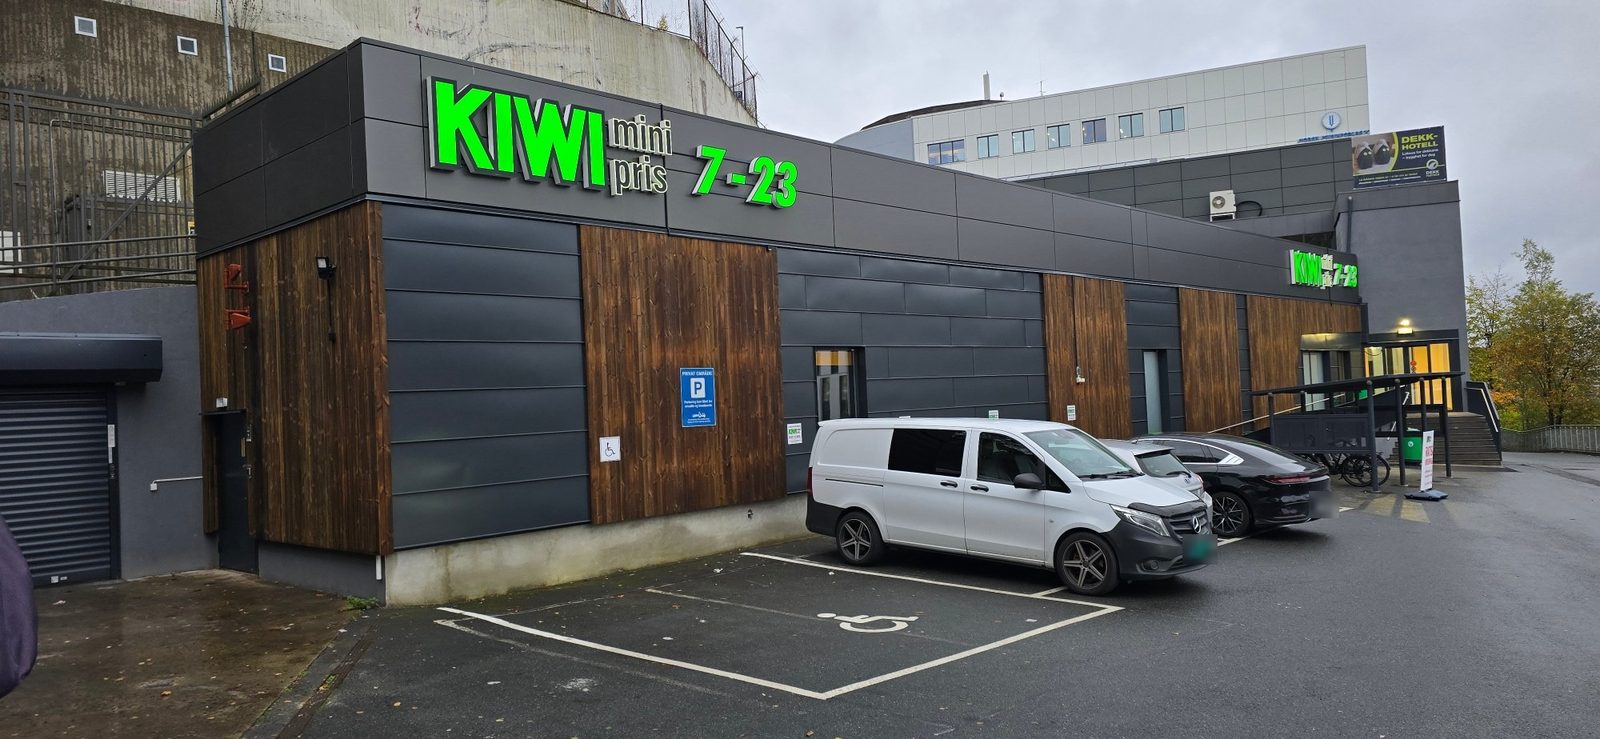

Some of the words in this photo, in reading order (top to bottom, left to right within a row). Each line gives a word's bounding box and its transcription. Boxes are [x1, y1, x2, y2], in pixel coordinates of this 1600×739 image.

[428, 76, 606, 191] KIWI
[608, 114, 673, 156] mini
[1401, 133, 1438, 144] DEKK-
[1401, 141, 1439, 150] HOTELL
[610, 155, 669, 196] pris
[1290, 250, 1323, 287] KIWI
[694, 382, 702, 395] P
